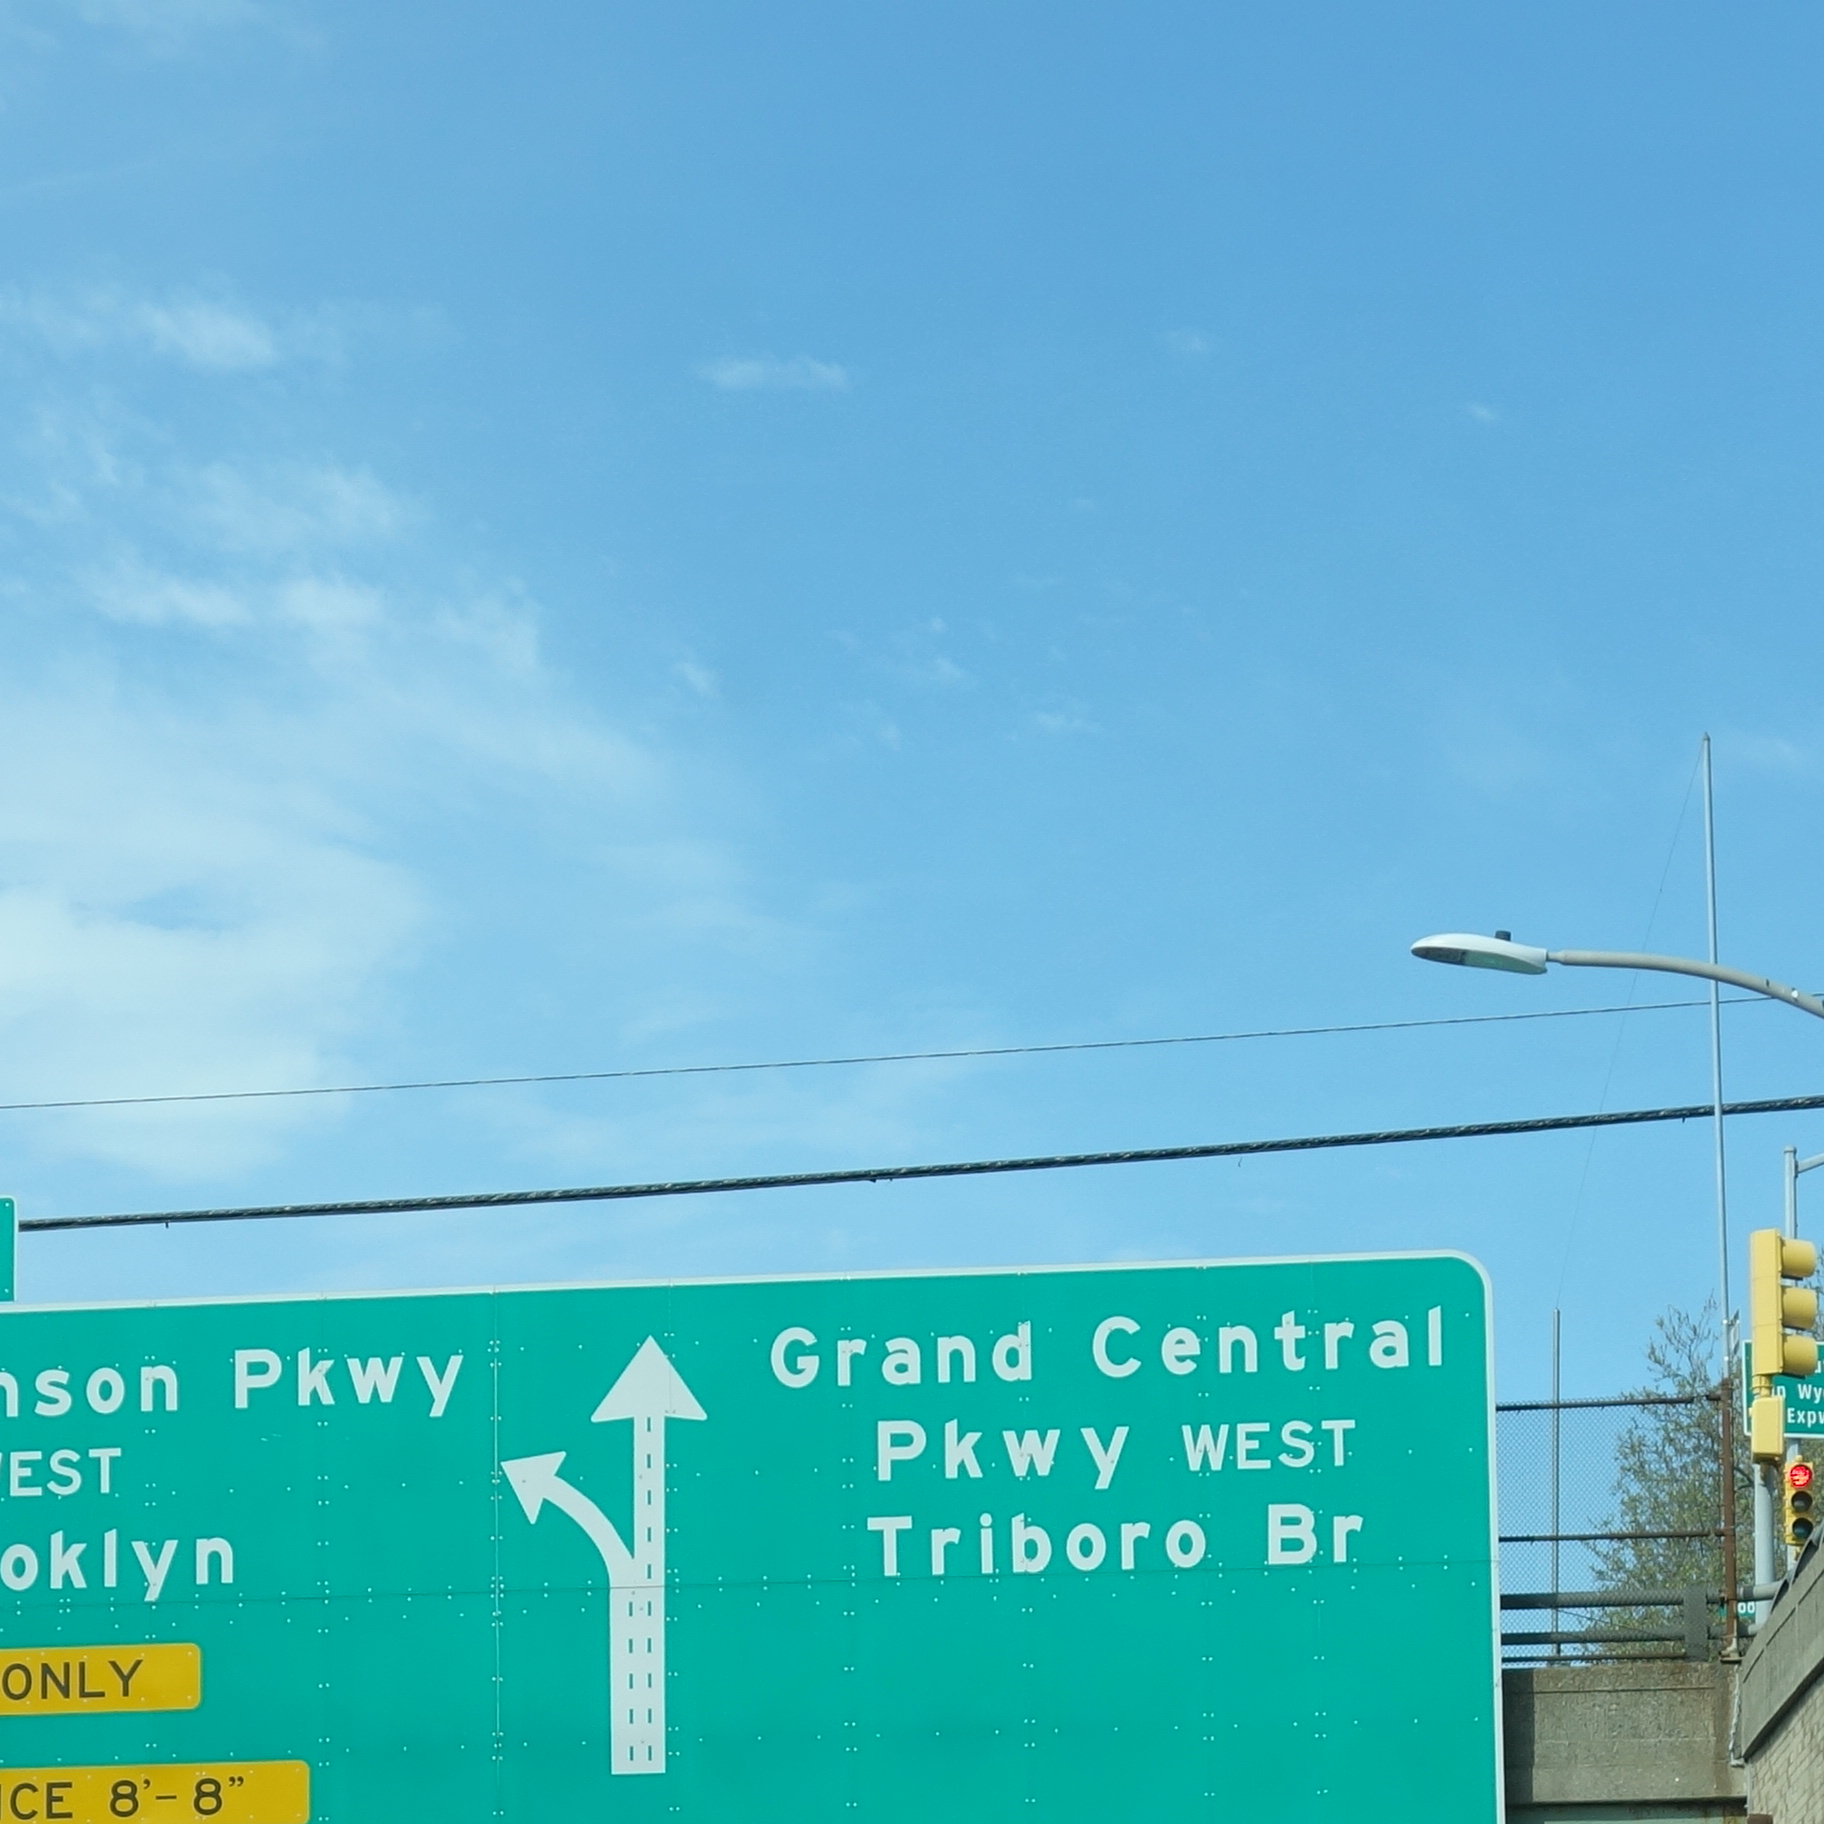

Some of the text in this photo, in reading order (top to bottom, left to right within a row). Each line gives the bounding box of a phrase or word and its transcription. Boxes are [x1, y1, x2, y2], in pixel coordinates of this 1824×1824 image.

[770, 1306, 1442, 1388] Grand Central
[234, 1348, 464, 1418] Pkwy
[877, 1418, 1356, 1489] Pkwy WEST
[866, 1503, 1363, 1577] Triboro Br
[1, 1659, 144, 1701] ONLY
